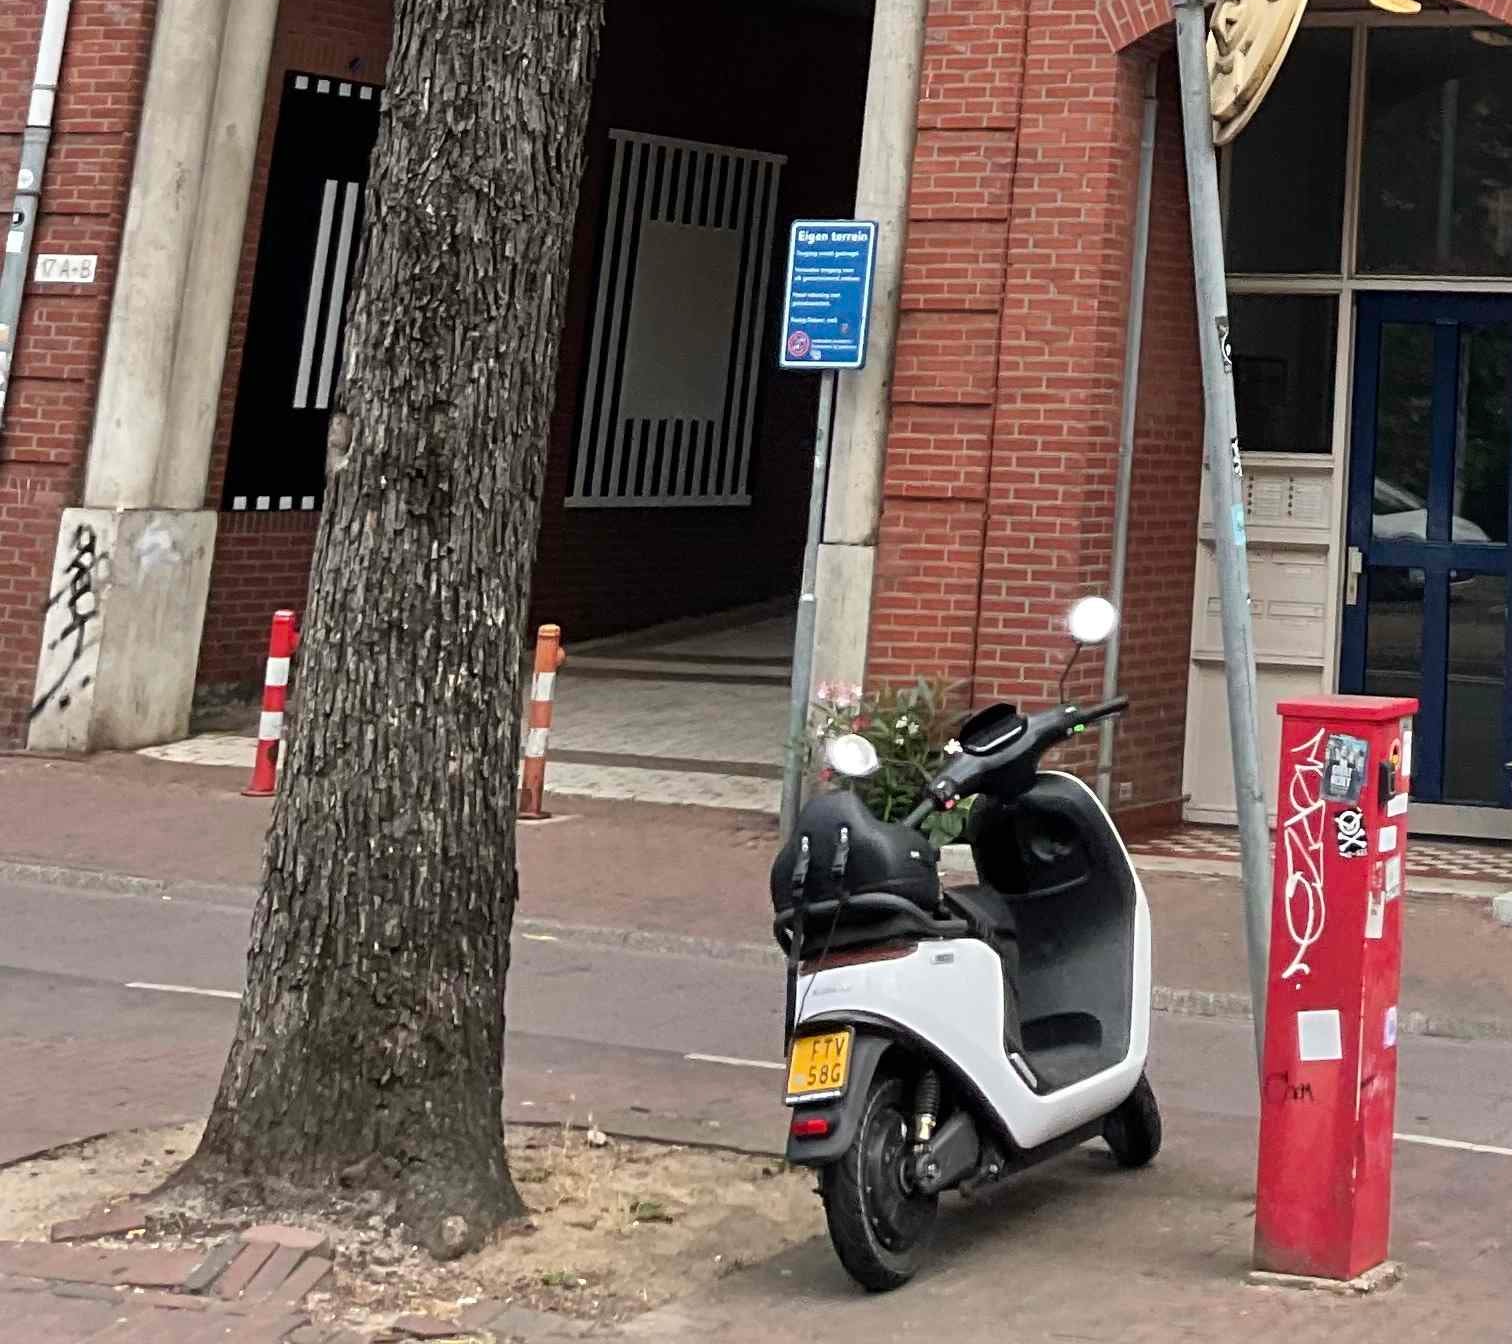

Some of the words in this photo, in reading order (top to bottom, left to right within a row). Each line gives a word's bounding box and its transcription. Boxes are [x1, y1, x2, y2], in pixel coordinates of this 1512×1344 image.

[798, 230, 829, 245] Eigen
[831, 230, 868, 242] terrein
[811, 1037, 846, 1061] FTV
[807, 1063, 841, 1086] 58G
